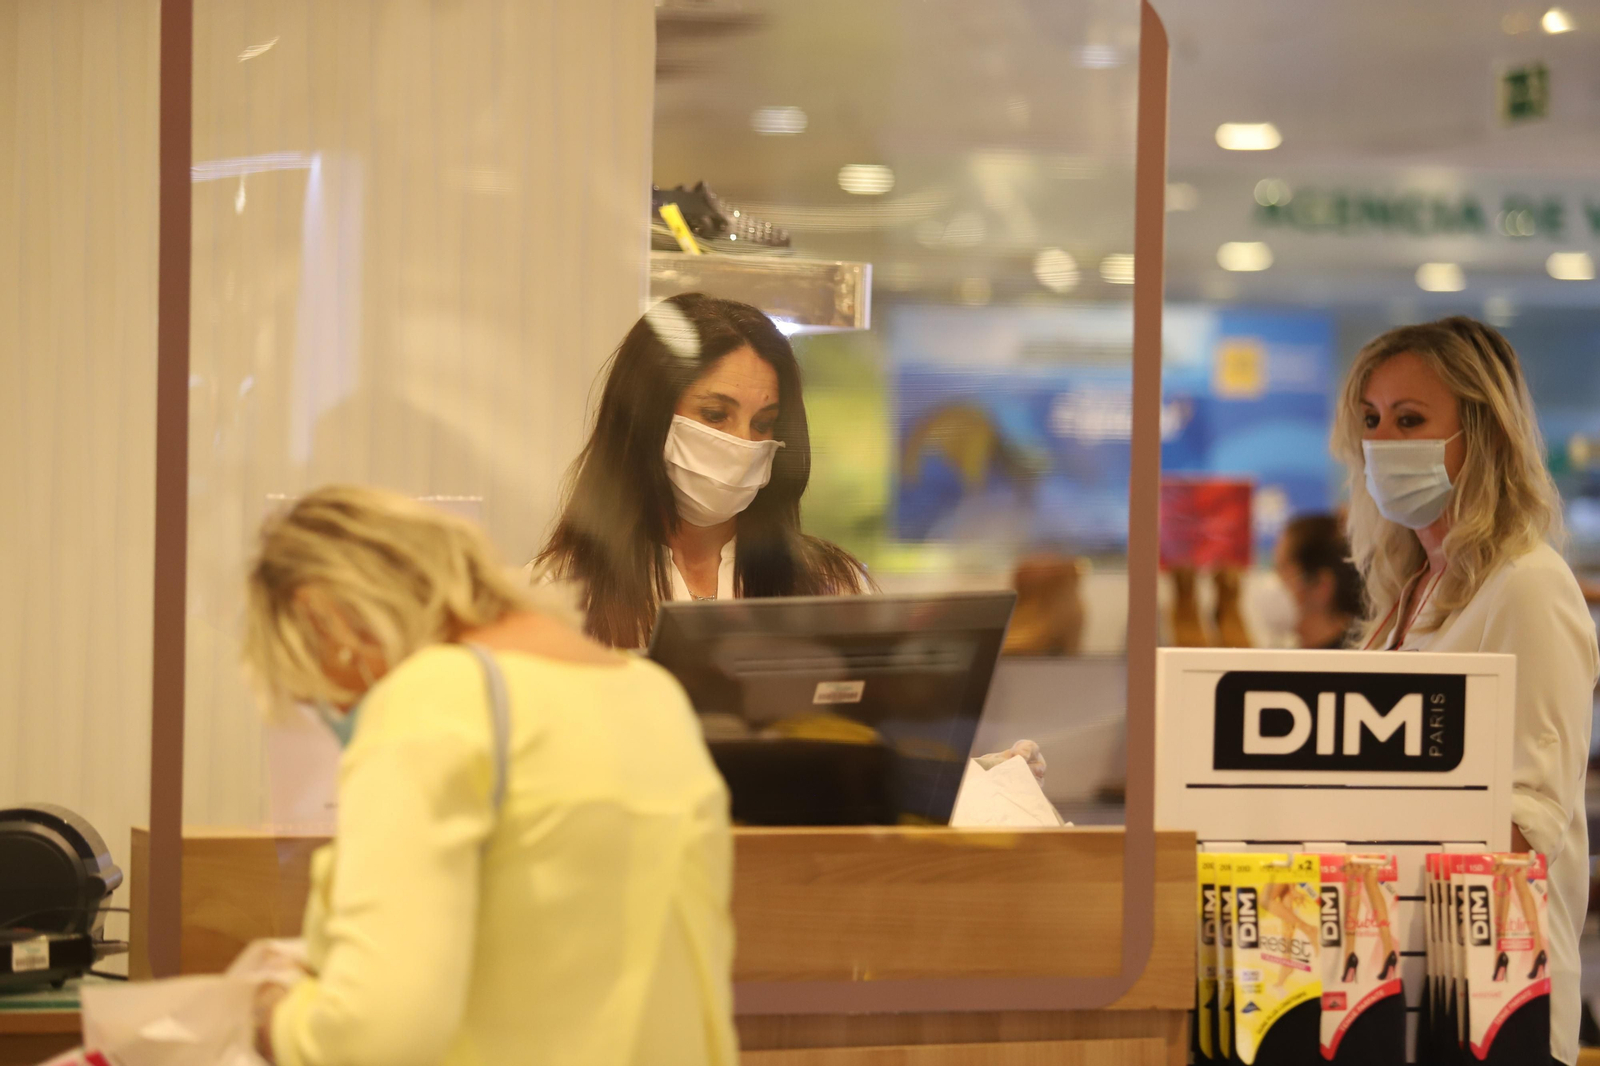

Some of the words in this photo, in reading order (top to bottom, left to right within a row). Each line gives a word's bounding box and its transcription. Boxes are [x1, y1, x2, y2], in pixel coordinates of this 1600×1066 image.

[1242, 690, 1424, 757] DIM
[1428, 692, 1446, 758] PARIS
[1238, 892, 1258, 943] DIM
[1321, 892, 1339, 941] DIM
[1469, 890, 1489, 940] DIM
